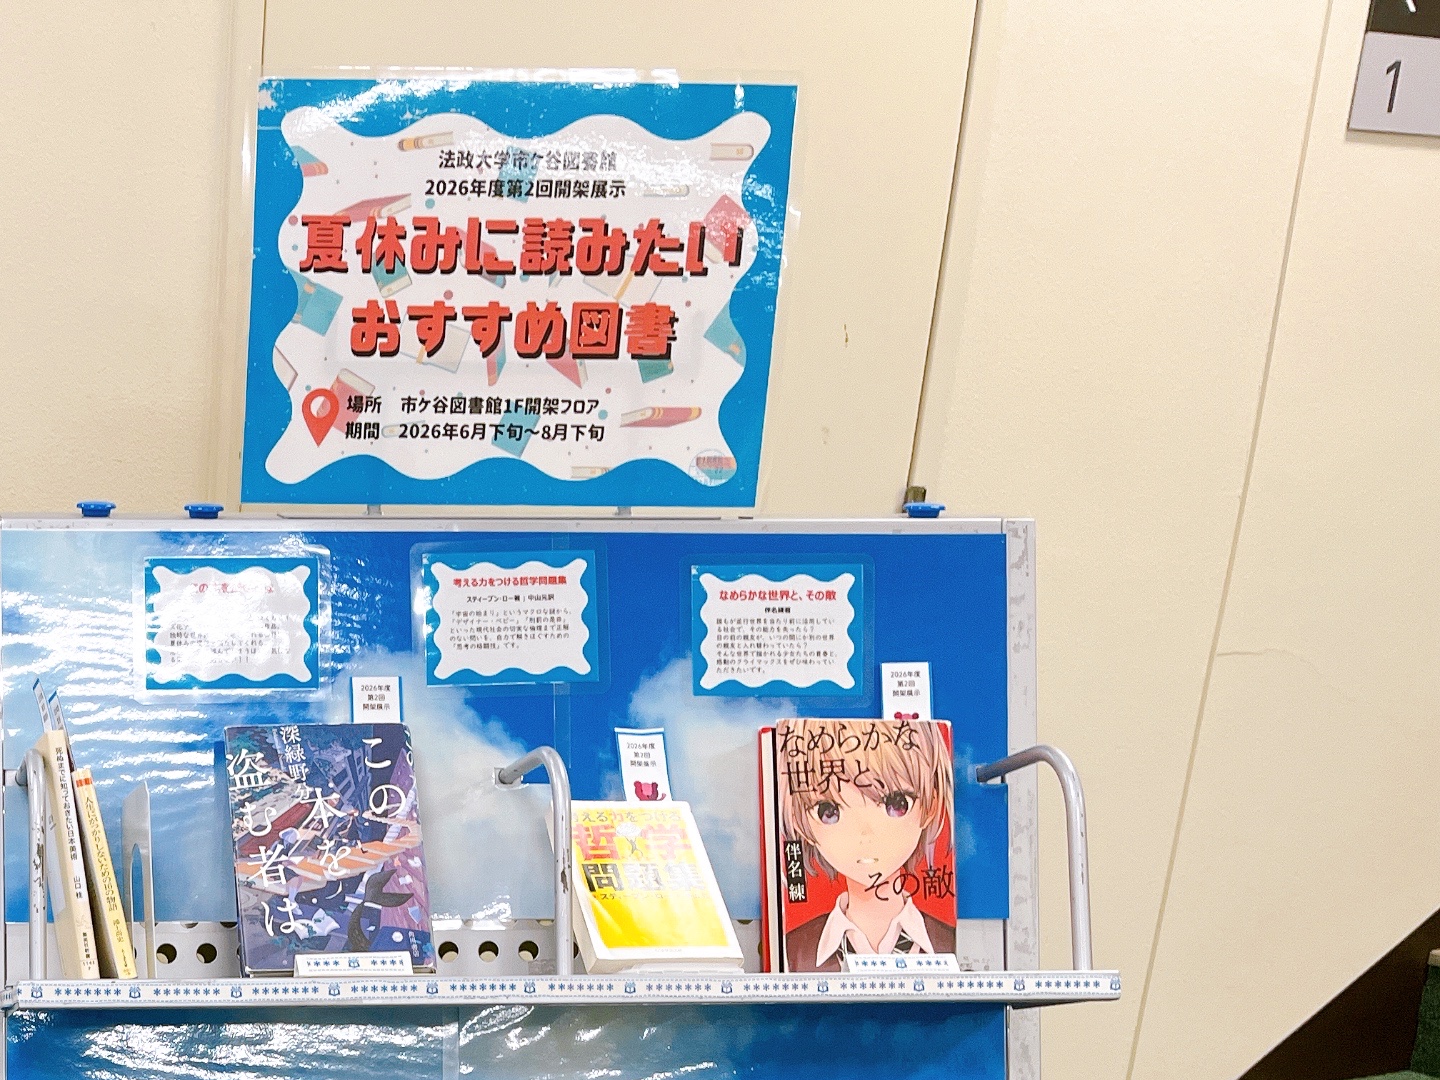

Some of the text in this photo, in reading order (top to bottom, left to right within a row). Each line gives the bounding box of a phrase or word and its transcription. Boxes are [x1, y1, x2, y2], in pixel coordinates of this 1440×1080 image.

[1386, 59, 1401, 112] 1
[425, 178, 626, 199] 2026年度第2回開架展示
[299, 214, 743, 276] 夏休みに読みたい
[349, 301, 679, 359] おすすめ図書
[347, 396, 382, 415] 場所
[345, 421, 380, 440] 期間
[453, 576, 567, 587] 考える力をつける哲学問題集
[719, 590, 837, 601] なめらかな世界と、その敵
[361, 684, 391, 692] 2026年度
[890, 671, 921, 679] 2026年度
[897, 680, 915, 688] 第2回
[779, 721, 920, 755] なめらかな
[361, 737, 406, 817] この
[780, 759, 887, 796] 世界と、
[226, 749, 310, 936] 盗む者は
[300, 787, 351, 876] 本を
[572, 824, 692, 861] 哲学
[582, 863, 706, 891] 問題集
[785, 842, 807, 902] 伴名練
[864, 863, 956, 902] その敵
